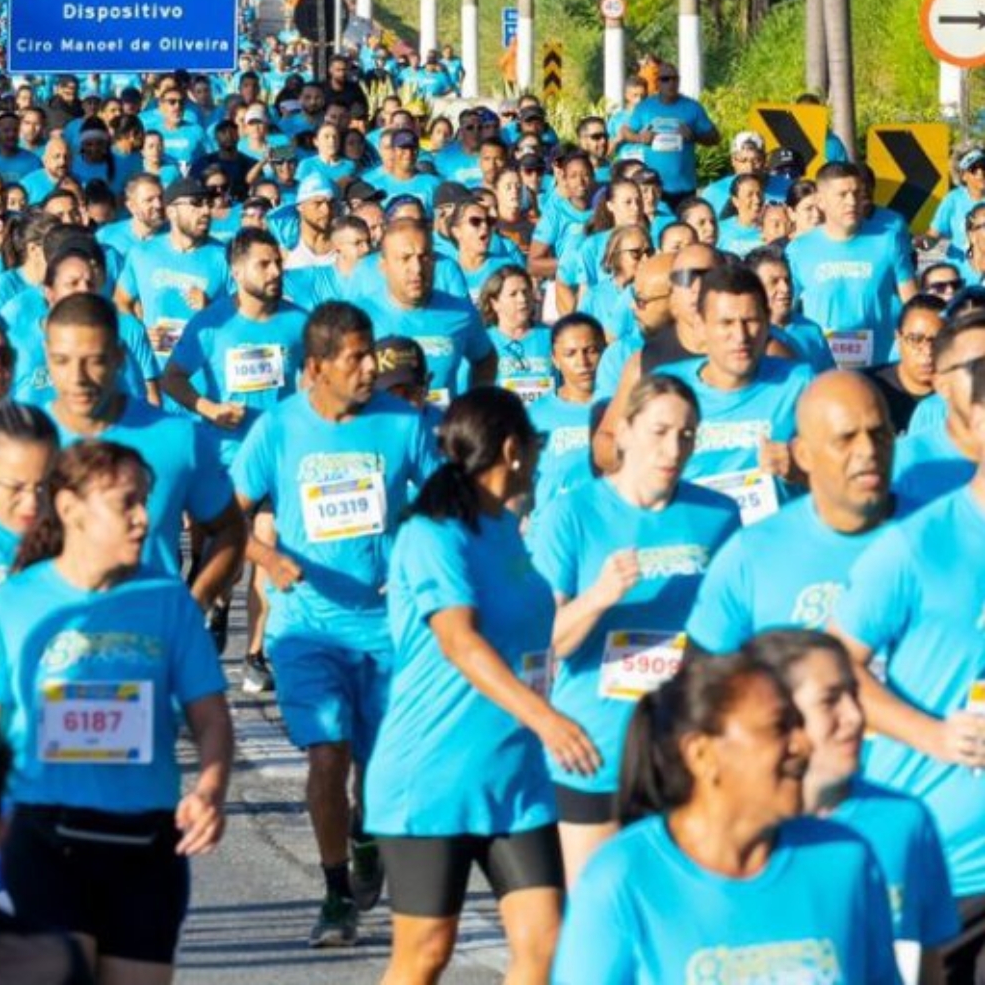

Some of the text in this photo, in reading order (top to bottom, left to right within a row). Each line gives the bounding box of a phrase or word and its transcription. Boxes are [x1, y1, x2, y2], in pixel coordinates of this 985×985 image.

[63, 2, 183, 23] Dispositivo
[16, 36, 229, 53] Ciro Manoel de Oliveira
[318, 497, 370, 520] 10319
[62, 709, 124, 733] 6187
